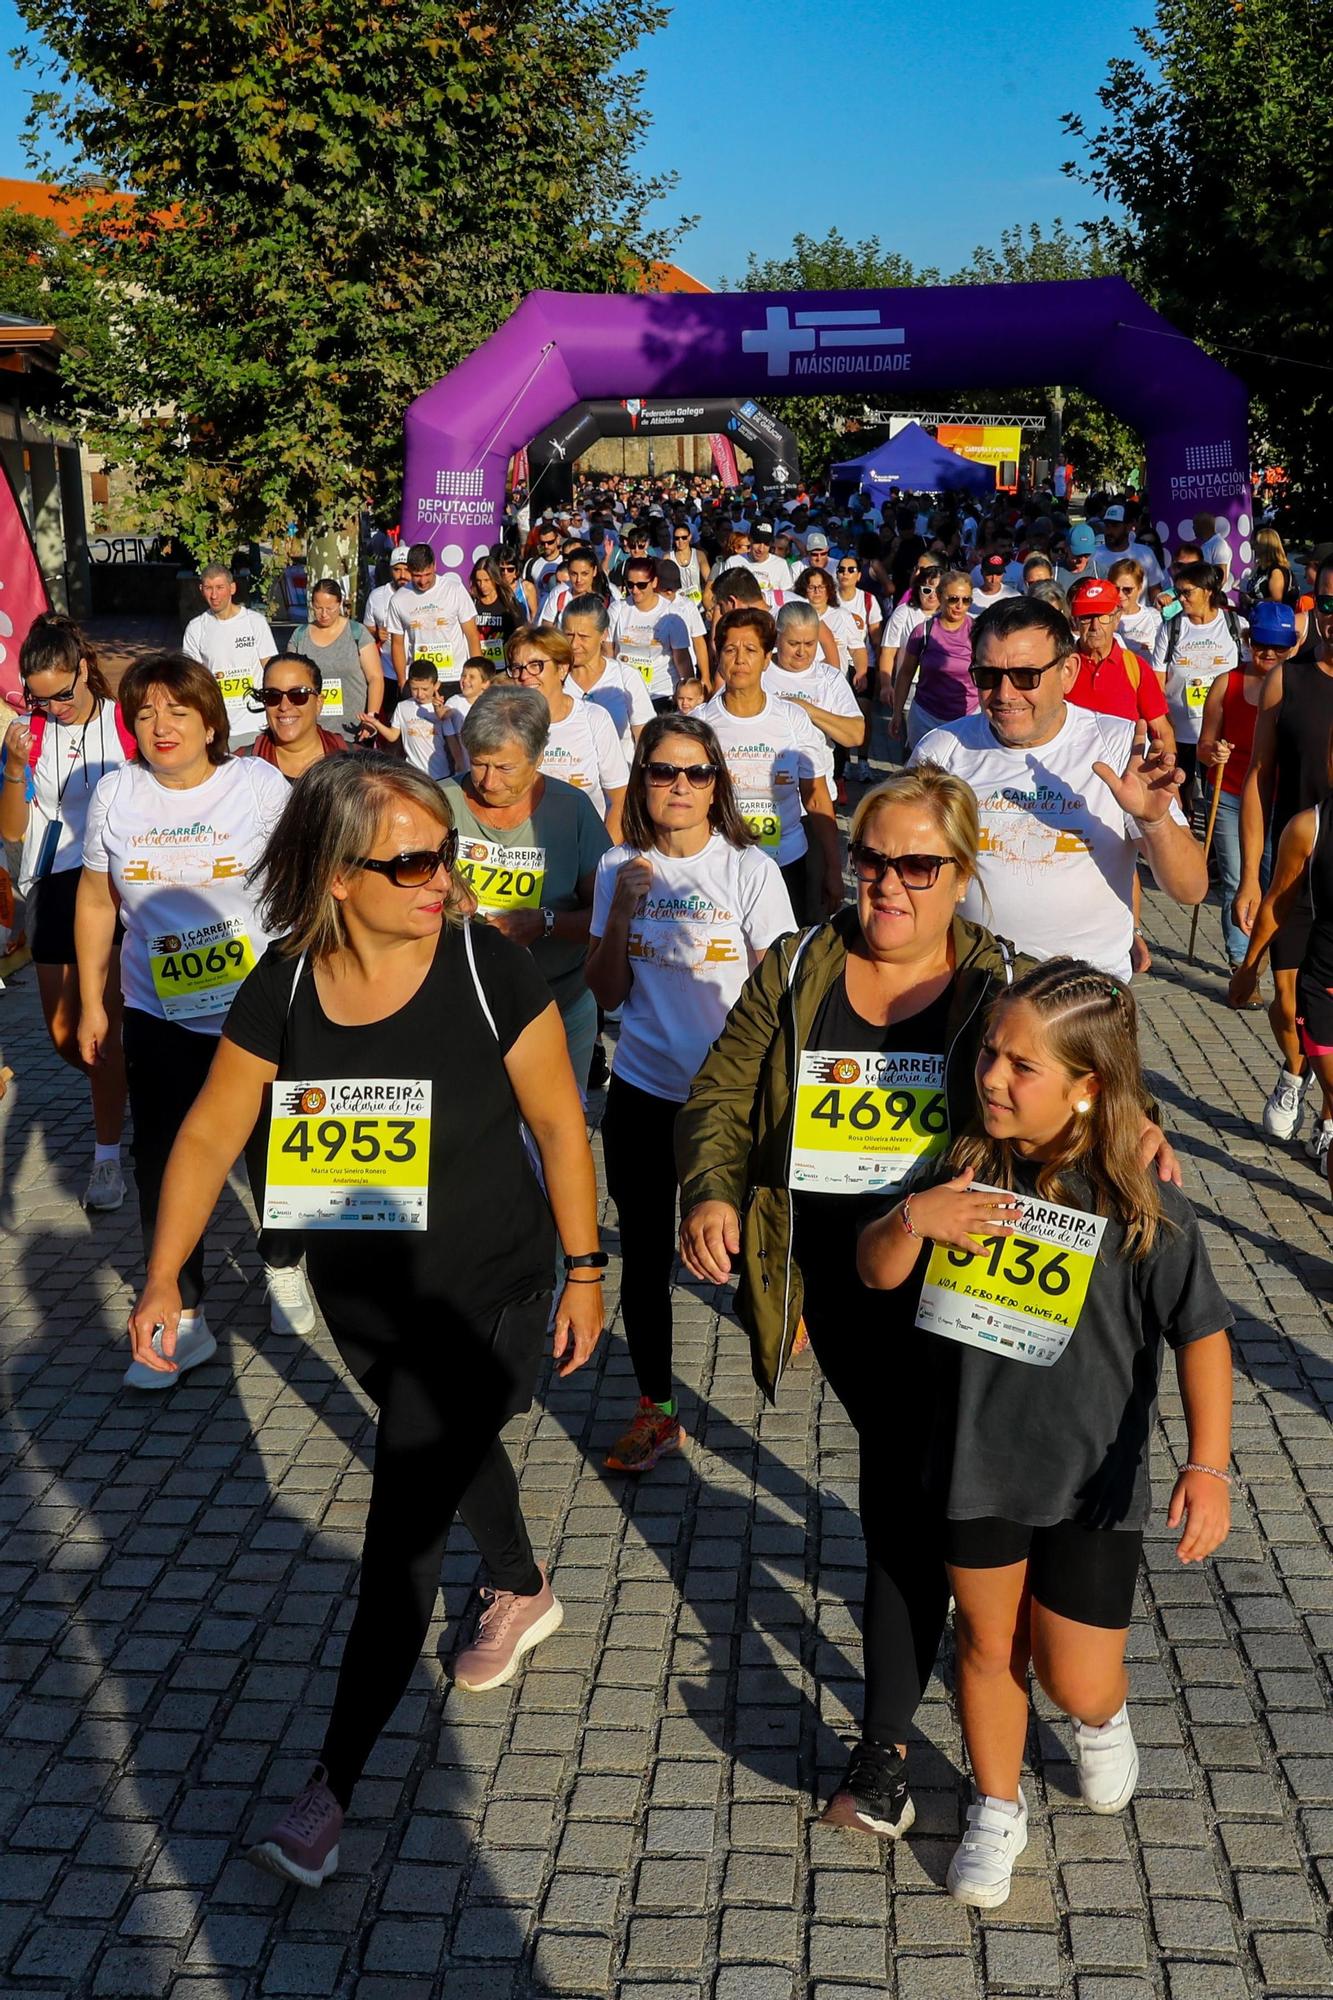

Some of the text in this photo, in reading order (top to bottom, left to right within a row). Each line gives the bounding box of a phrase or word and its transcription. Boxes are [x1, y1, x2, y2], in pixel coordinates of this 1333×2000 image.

[795, 354, 911, 375] MÁISIGUALDADE
[641, 406, 704, 418] Federación Galega
[641, 416, 685, 426] de Atletismo
[1171, 468, 1245, 488] DEPUTACIÓN
[1172, 484, 1247, 501] PONTEVEDRA
[418, 498, 495, 514] DEPUTACIÓN
[417, 511, 494, 526] PONTEVEDRA
[991, 790, 1063, 801] A CARREIRA
[1041, 800, 1056, 810] de
[1060, 798, 1083, 815] Leo
[150, 824, 214, 836] A CARREIRA
[131, 831, 232, 848] solidaria de Leo
[460, 863, 536, 897] 4720
[647, 899, 715, 911] A CARREIRA
[182, 918, 241, 942] I CARREIRA
[161, 940, 245, 982] 4069
[866, 1058, 946, 1075] I CARREIR
[865, 1070, 922, 1085] solidaria
[924, 1074, 938, 1083] de
[331, 1084, 425, 1101] I CARREIRA
[330, 1098, 425, 1116] solidaria de Leo
[811, 1089, 949, 1134] 4696
[281, 1120, 417, 1163] 4953
[1057, 1229, 1072, 1243] de
[1071, 1231, 1094, 1251] Leo
